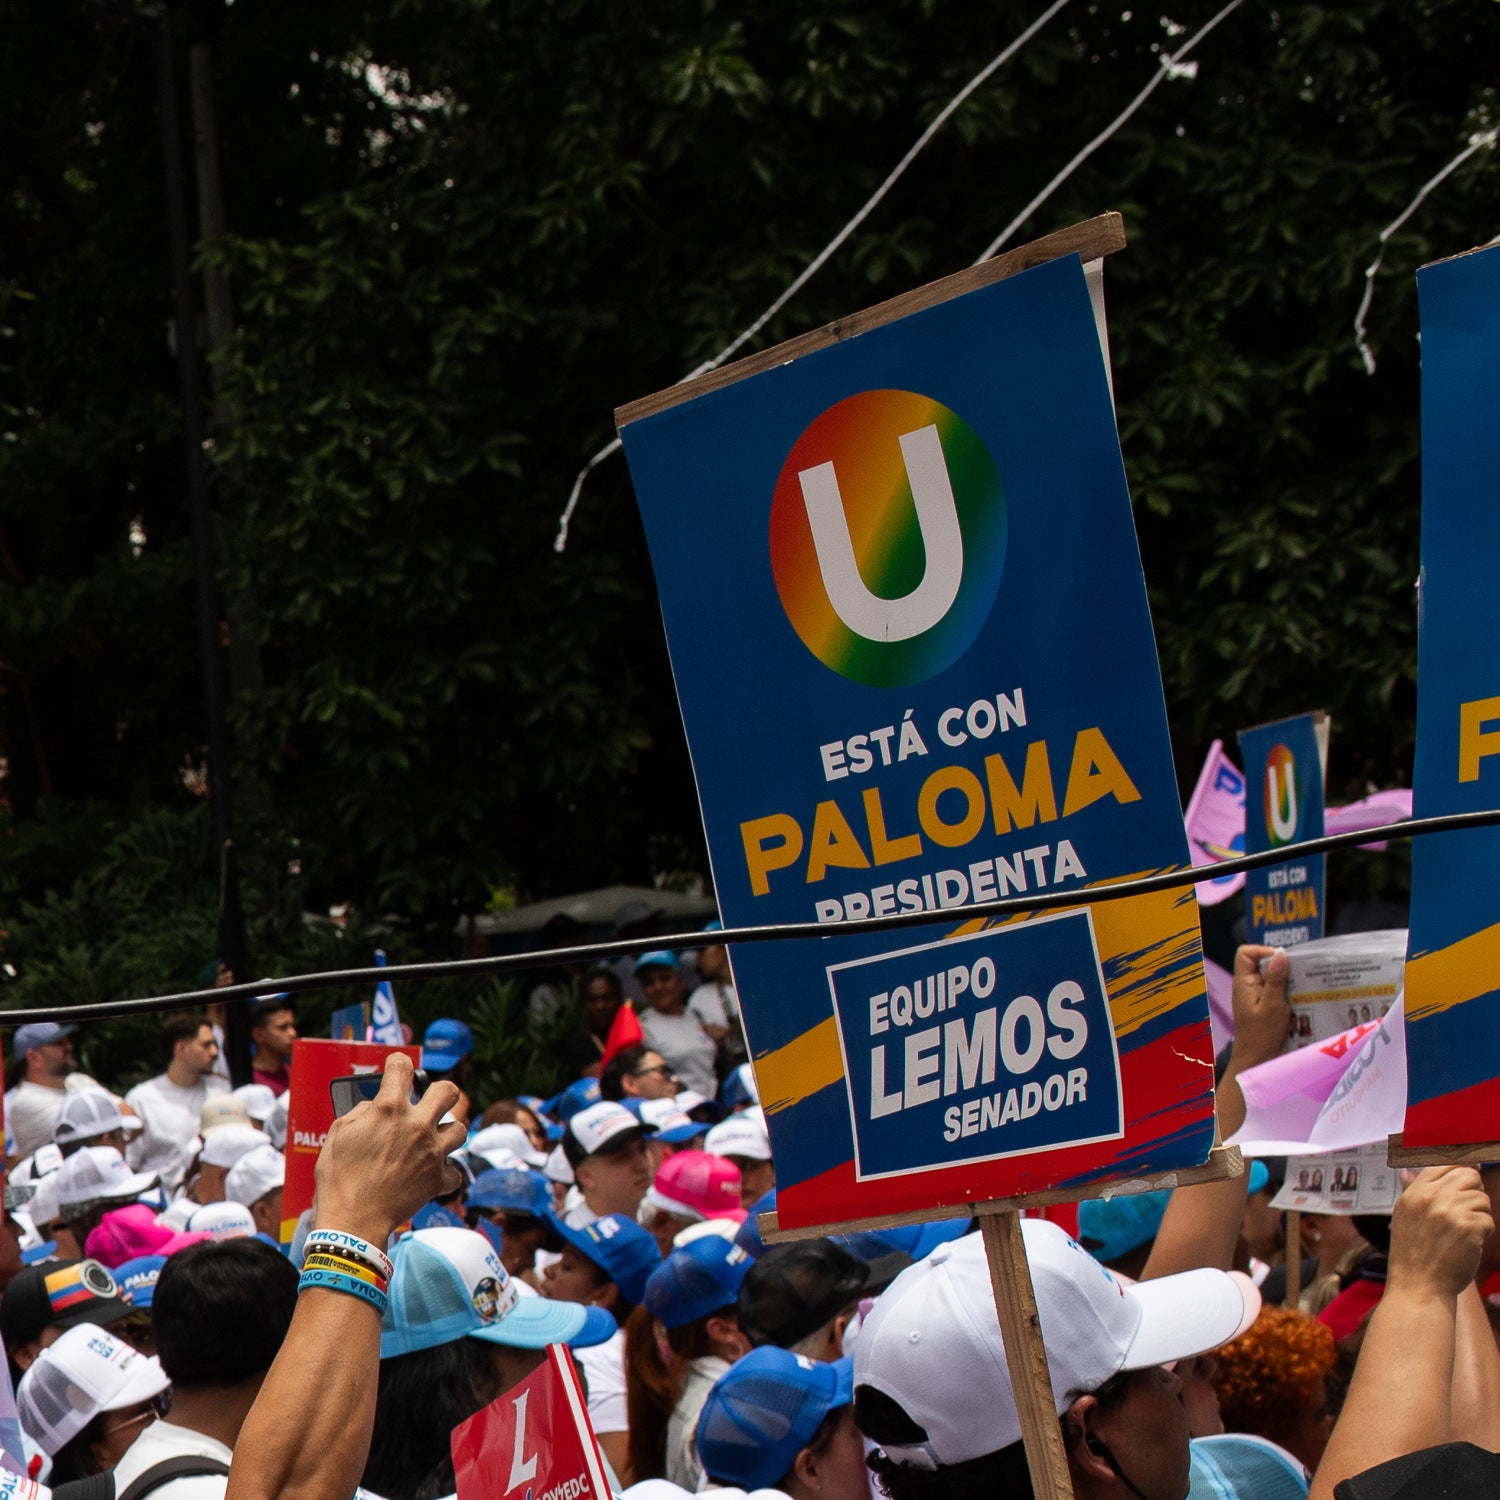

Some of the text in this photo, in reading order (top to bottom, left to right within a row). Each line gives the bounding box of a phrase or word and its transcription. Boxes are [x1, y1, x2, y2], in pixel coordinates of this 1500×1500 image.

[797, 421, 966, 644] U
[819, 687, 1029, 785] ESTÁ CON
[739, 724, 1143, 898] PALOMA
[1268, 762, 1298, 841] U
[814, 839, 1089, 940] PRESIDENTA
[1252, 887, 1318, 927] PALOMA
[1290, 866, 1308, 884] CON
[869, 955, 997, 1038] EQUIPO
[869, 980, 1091, 1122] LEMOS
[941, 1066, 1089, 1144] SENADOR
[310, 1232, 368, 1253] PALOMA
[504, 1388, 538, 1496] L
